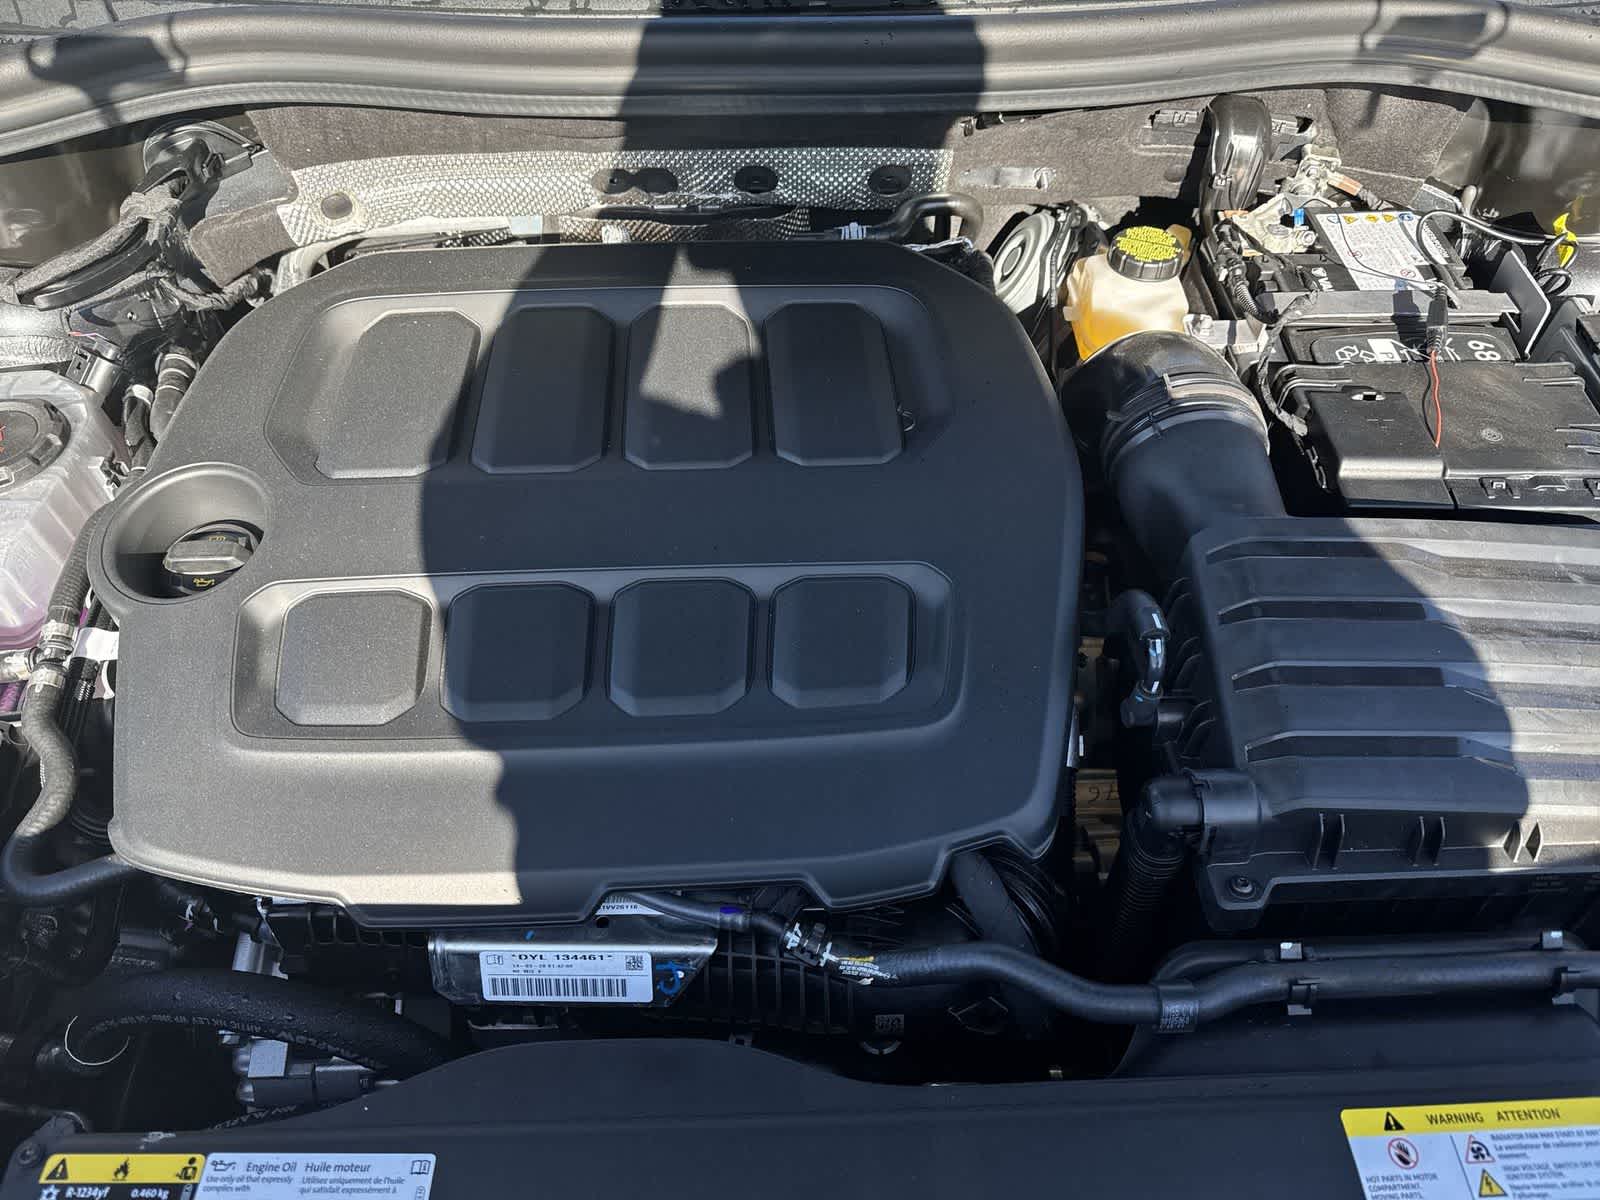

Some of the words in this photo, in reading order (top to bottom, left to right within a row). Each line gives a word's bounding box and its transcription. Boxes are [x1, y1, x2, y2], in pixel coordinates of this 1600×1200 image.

[1426, 1111, 1484, 1126] WARNING
[1496, 1108, 1561, 1122] ATTENTION
[246, 1161, 280, 1175] Engine
[282, 1161, 298, 1173] Oil
[304, 1162, 333, 1173] Huile
[333, 1163, 372, 1173] moteur
[246, 1176, 260, 1184] that
[261, 1176, 294, 1185] expressly
[329, 1176, 372, 1186] uniquement
[373, 1176, 383, 1184] de
[1366, 1175, 1380, 1184] HOT
[1381, 1174, 1404, 1183] PARTS
[1404, 1173, 1412, 1181] IN
[1412, 1172, 1439, 1181] MOTOR
[65, 1186, 111, 1200] R-1234yf
[130, 1188, 157, 1199] 0.460
[158, 1187, 170, 1200] kg
[203, 1184, 234, 1194] complies
[235, 1184, 251, 1192] with
[299, 1186, 312, 1195] qui
[312, 1185, 341, 1194] satisfait
[1371, 1192, 1400, 1200] MOVING
